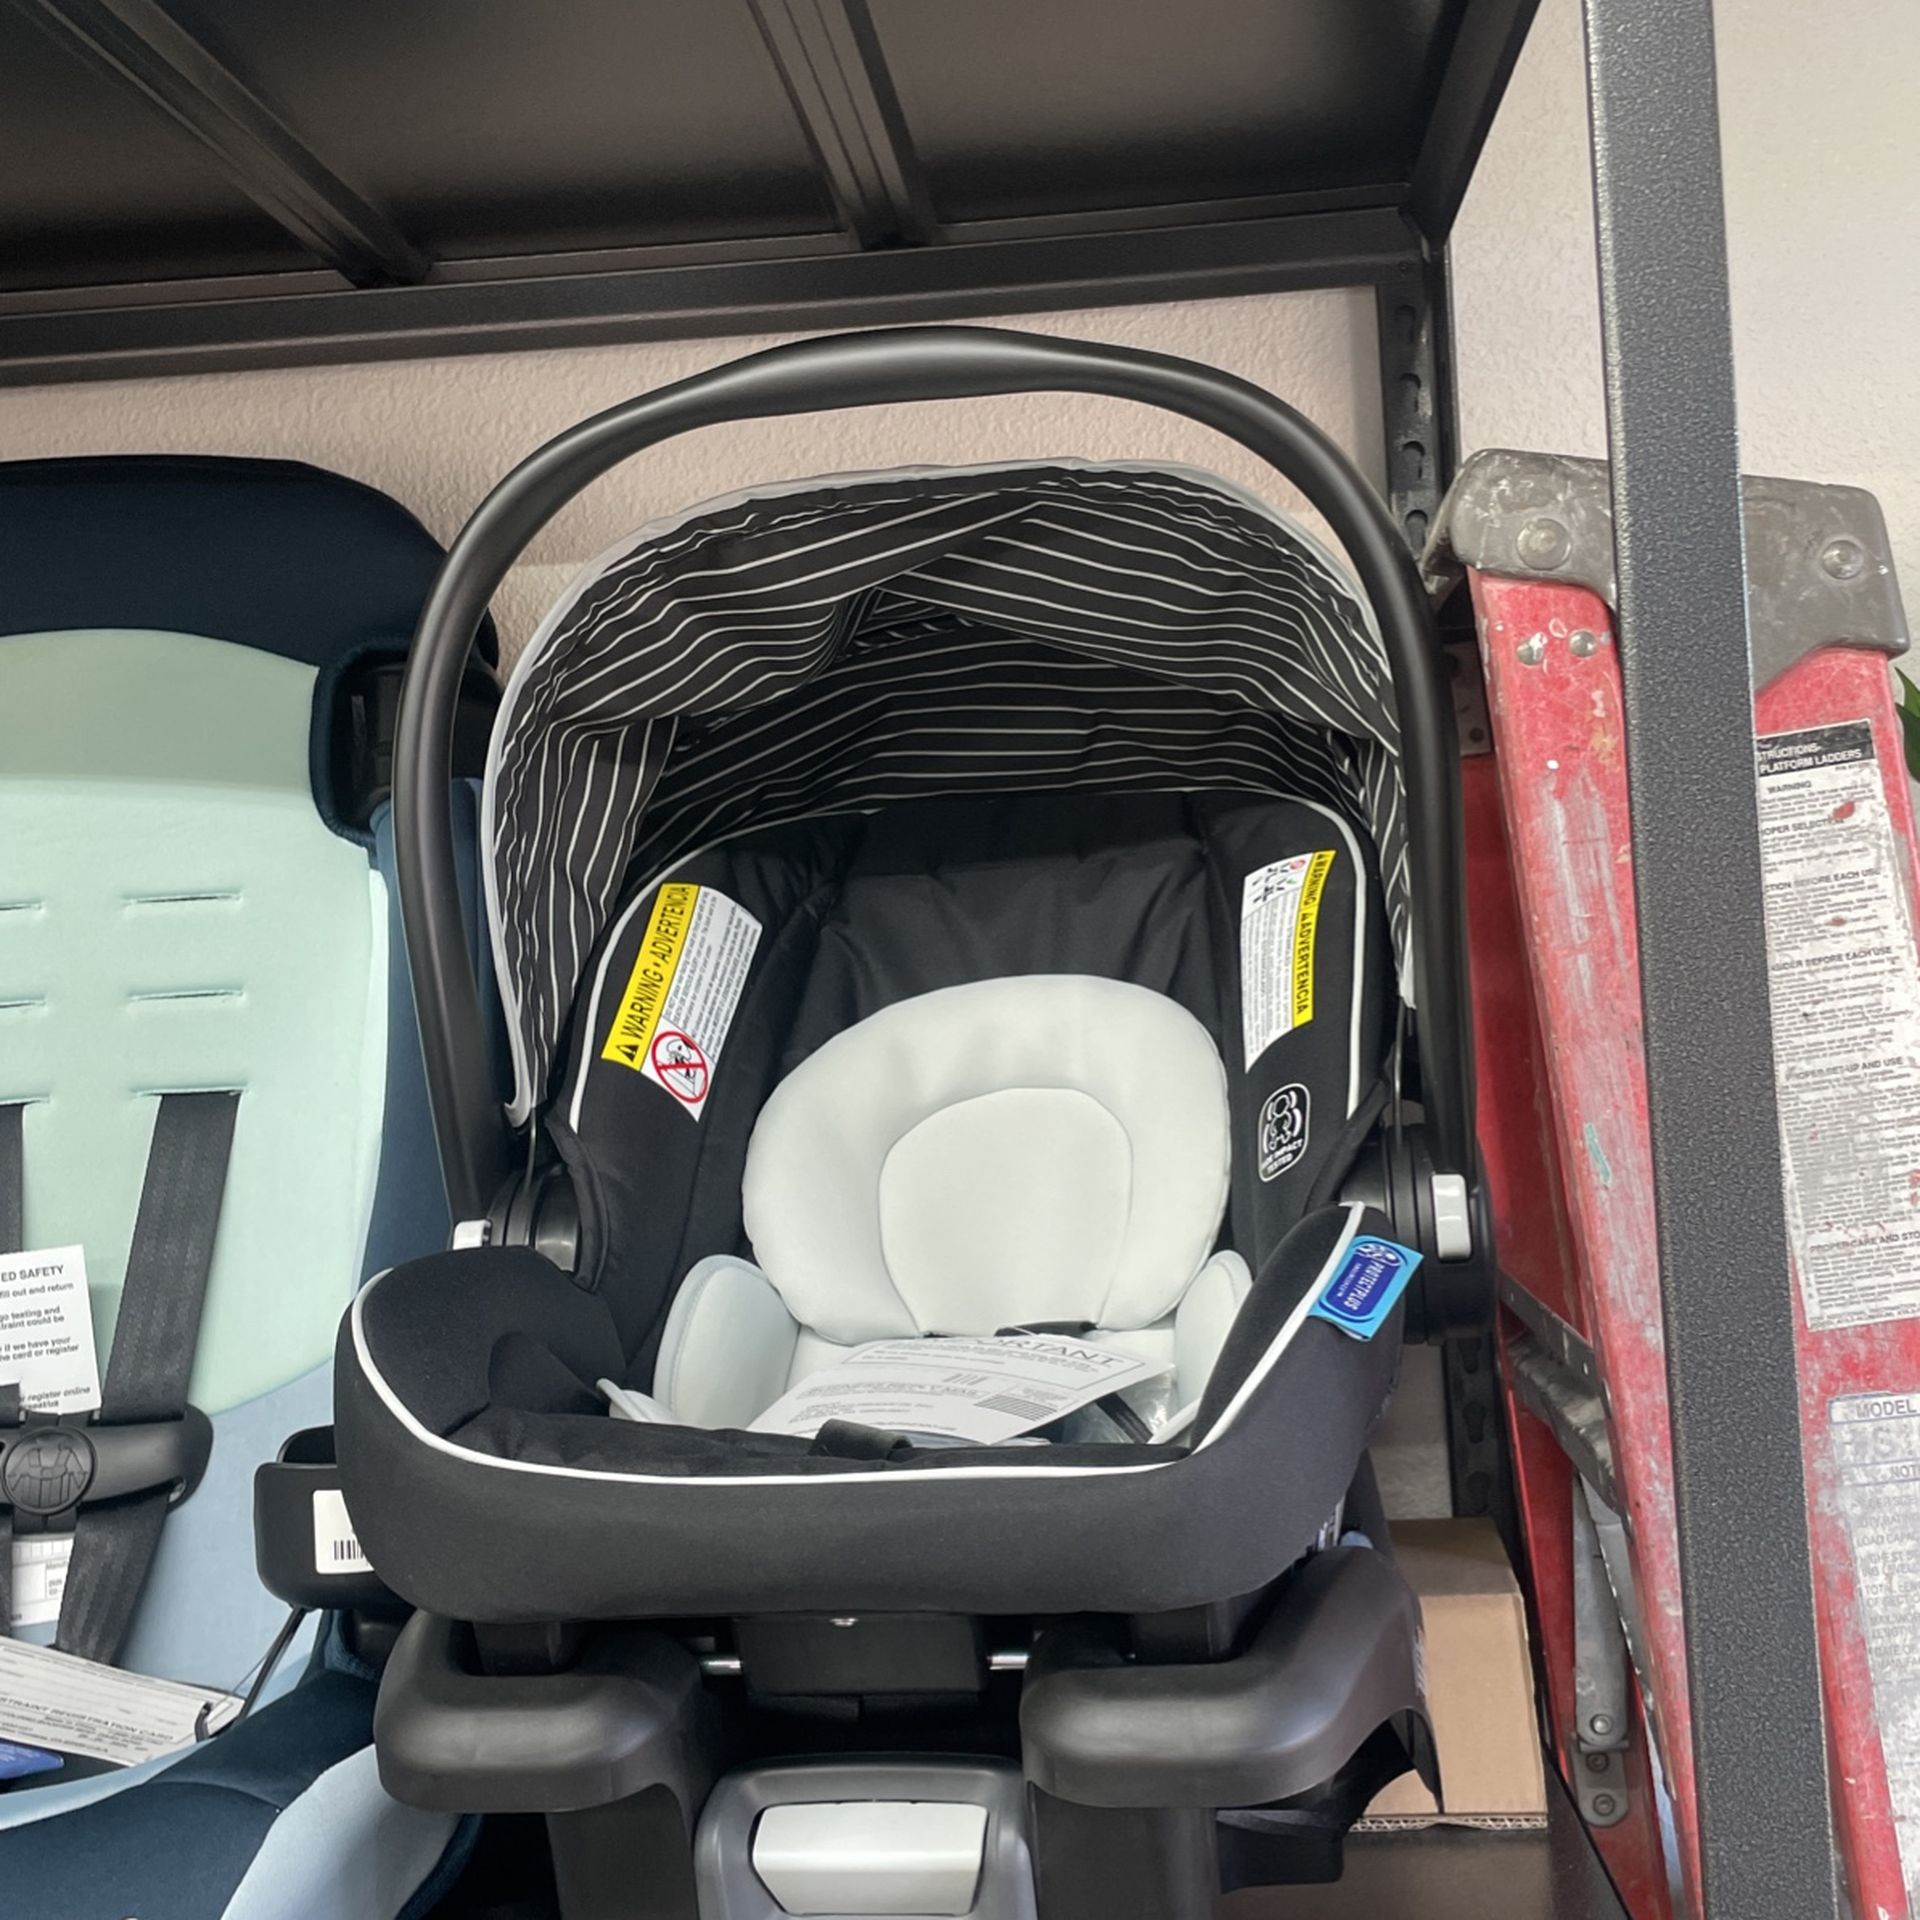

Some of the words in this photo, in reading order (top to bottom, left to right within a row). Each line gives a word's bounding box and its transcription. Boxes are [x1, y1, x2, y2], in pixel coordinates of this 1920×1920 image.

[1760, 756, 1813, 773] PLATFORM
[1815, 749, 1862, 764] LADDERS
[1767, 781, 1812, 793] WARNING
[1833, 871, 1860, 881] EACH
[1805, 954, 1843, 966] BEFORE
[1871, 946, 1892, 956] USE
[620, 967, 664, 1041] WARNING
[650, 886, 691, 965] ADVERTENCIA
[1296, 922, 1313, 1015] ADVERTENCIA
[1862, 1060, 1881, 1069] AND
[1883, 1056, 1902, 1066] USE
[1880, 1233, 1899, 1243] AND
[19, 1264, 64, 1280] SAFETY
[12, 1288, 26, 1297] out
[29, 1285, 46, 1295] and
[47, 1283, 74, 1292] return
[44, 1305, 61, 1315] and
[27, 1316, 51, 1326] could
[12, 1343, 26, 1351] we
[27, 1340, 49, 1348] have
[46, 1344, 79, 1355] register
[27, 1391, 61, 1401] register
[63, 1387, 90, 1397] online
[1856, 1400, 1917, 1418] MODEL
